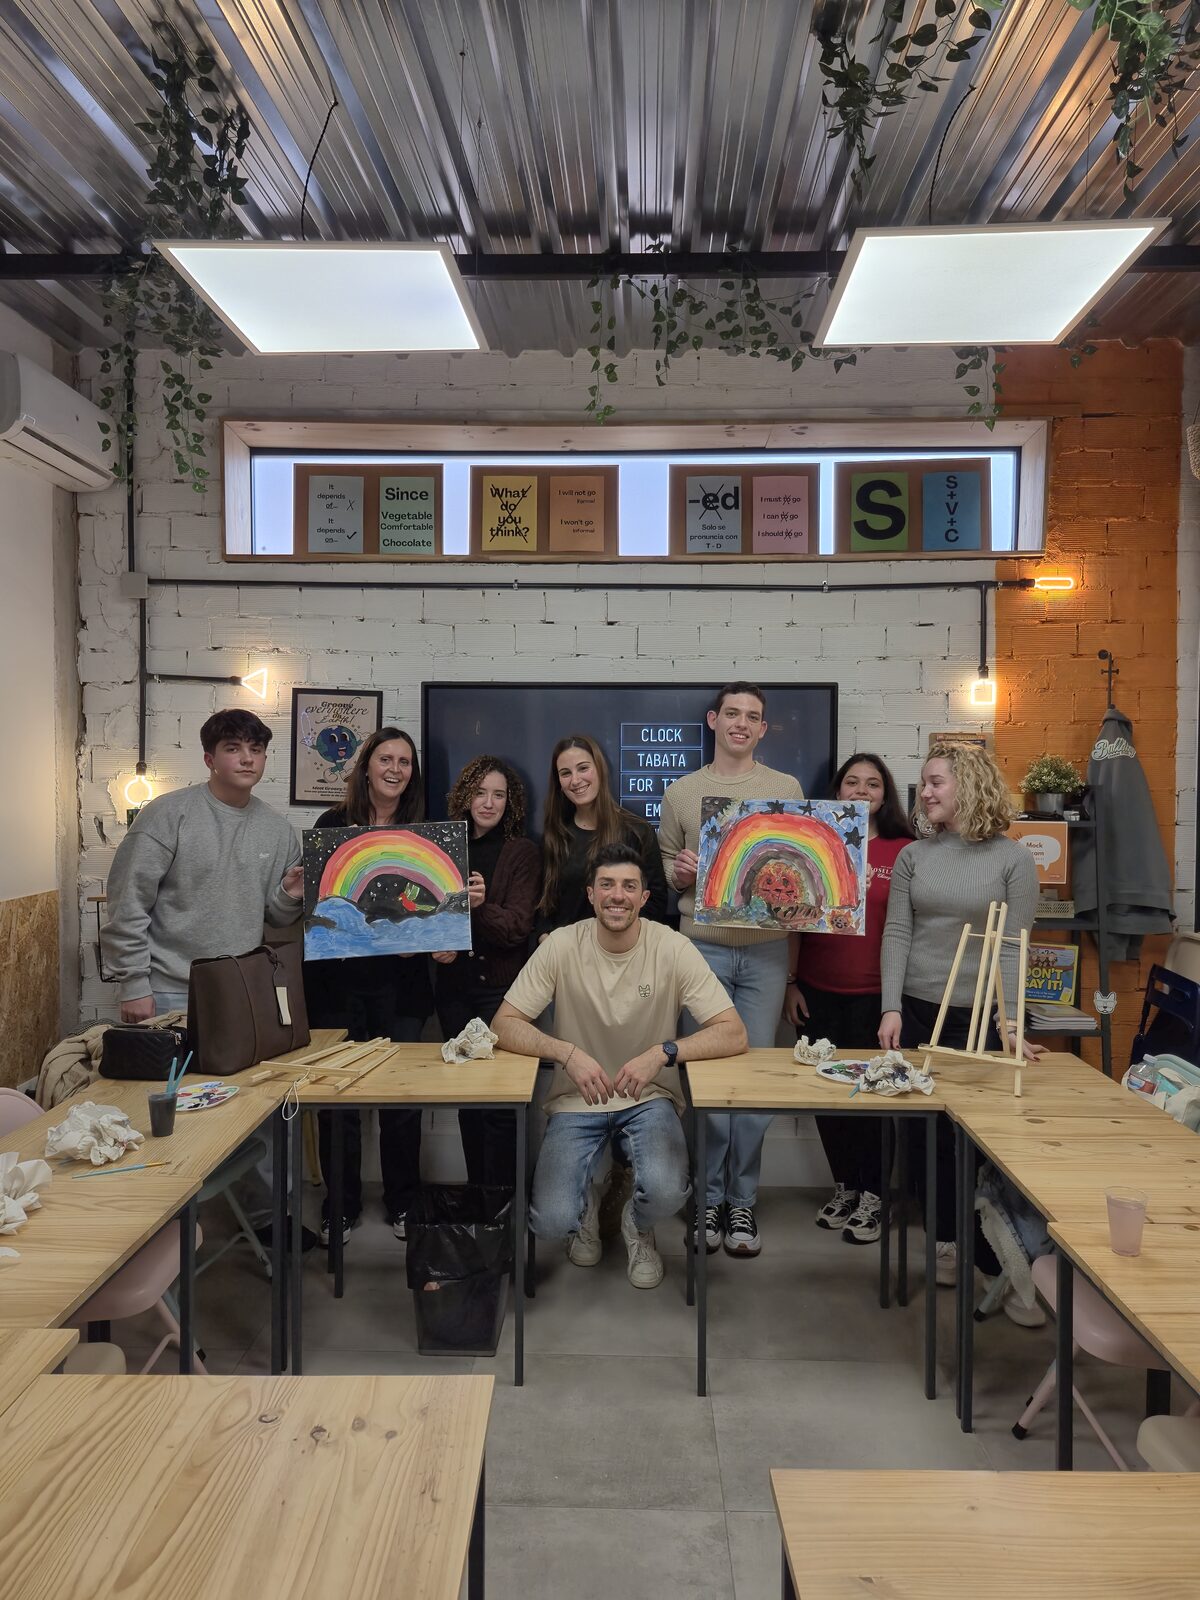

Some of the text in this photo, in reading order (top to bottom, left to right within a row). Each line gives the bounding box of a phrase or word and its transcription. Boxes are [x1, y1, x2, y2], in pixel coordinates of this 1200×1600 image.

[385, 487, 429, 501] Since
[490, 487, 528, 498] What
[500, 501, 517, 511] do
[853, 480, 906, 540] S
[381, 511, 433, 521] Vegetable
[498, 516, 521, 527] you
[380, 523, 434, 531] Comfortable
[489, 526, 529, 537] think?
[382, 538, 432, 547] Chocolate
[690, 533, 724, 541] pronuncia
[641, 728, 682, 742] CLOCK
[637, 753, 686, 767] TABATA
[629, 778, 653, 792] FOR
[645, 803, 661, 817] EM
[1047, 979, 1063, 990] IT!
